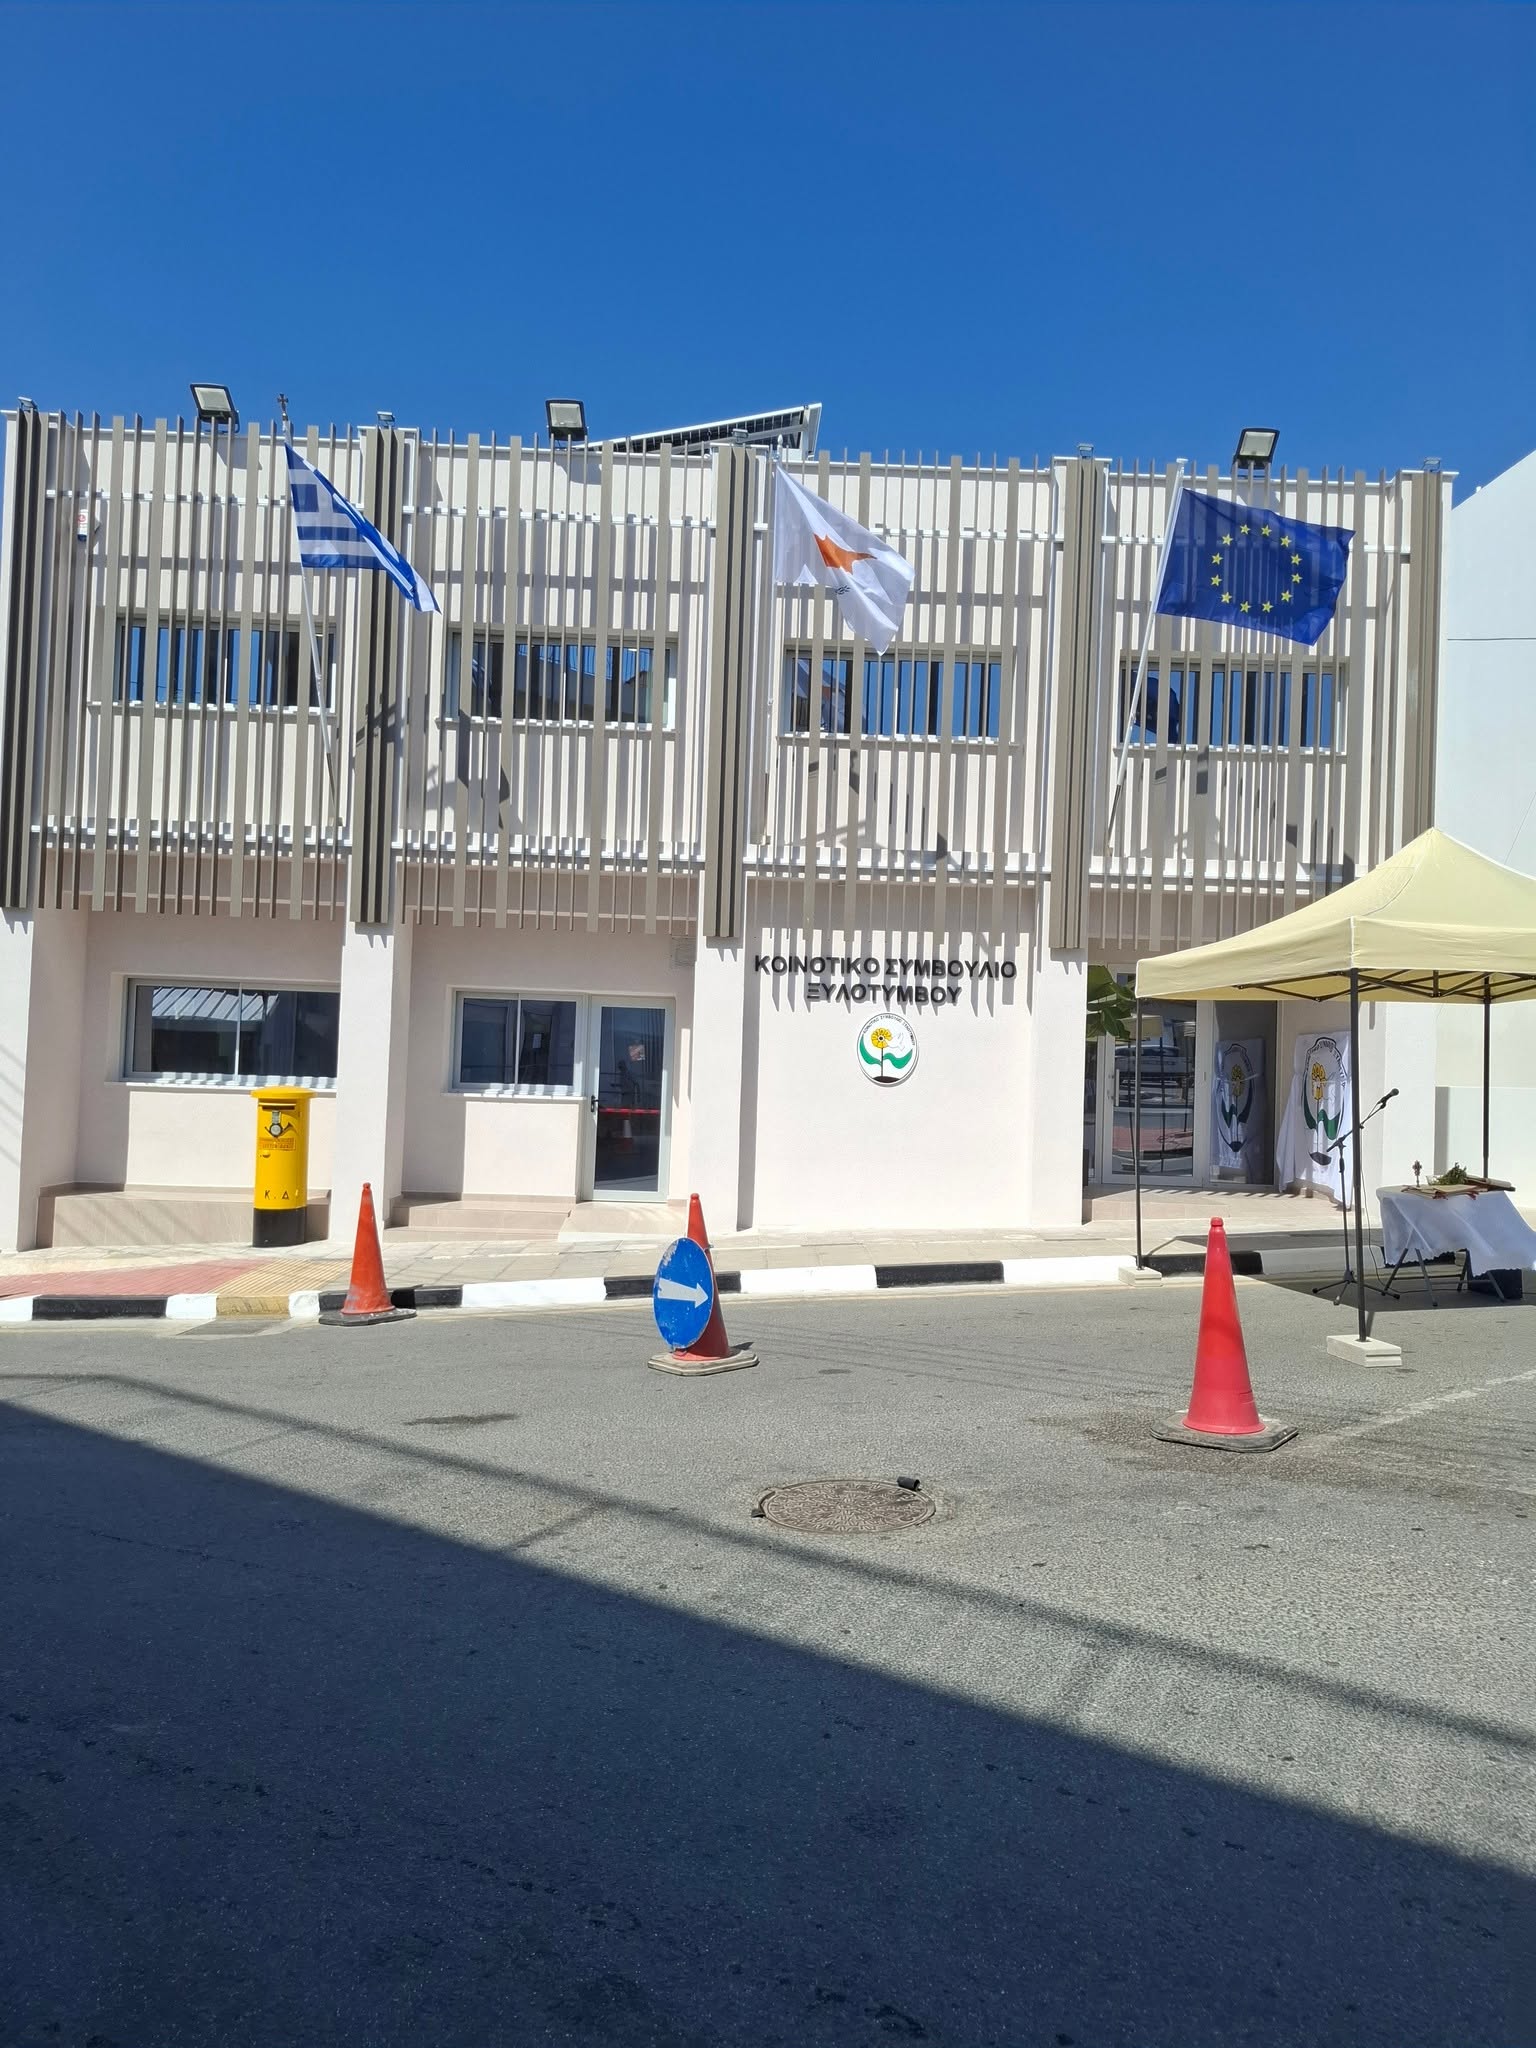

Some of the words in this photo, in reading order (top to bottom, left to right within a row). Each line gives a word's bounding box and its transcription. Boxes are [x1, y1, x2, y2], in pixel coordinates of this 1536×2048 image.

[755, 955, 880, 976] ΚΟΙΝΟΤΙΚΟ
[885, 957, 1017, 979] ΣΥΜΒΟΥΛΙΟ
[806, 983, 960, 1004] ΞΥΛΟΤΥΜΒΟΥ
